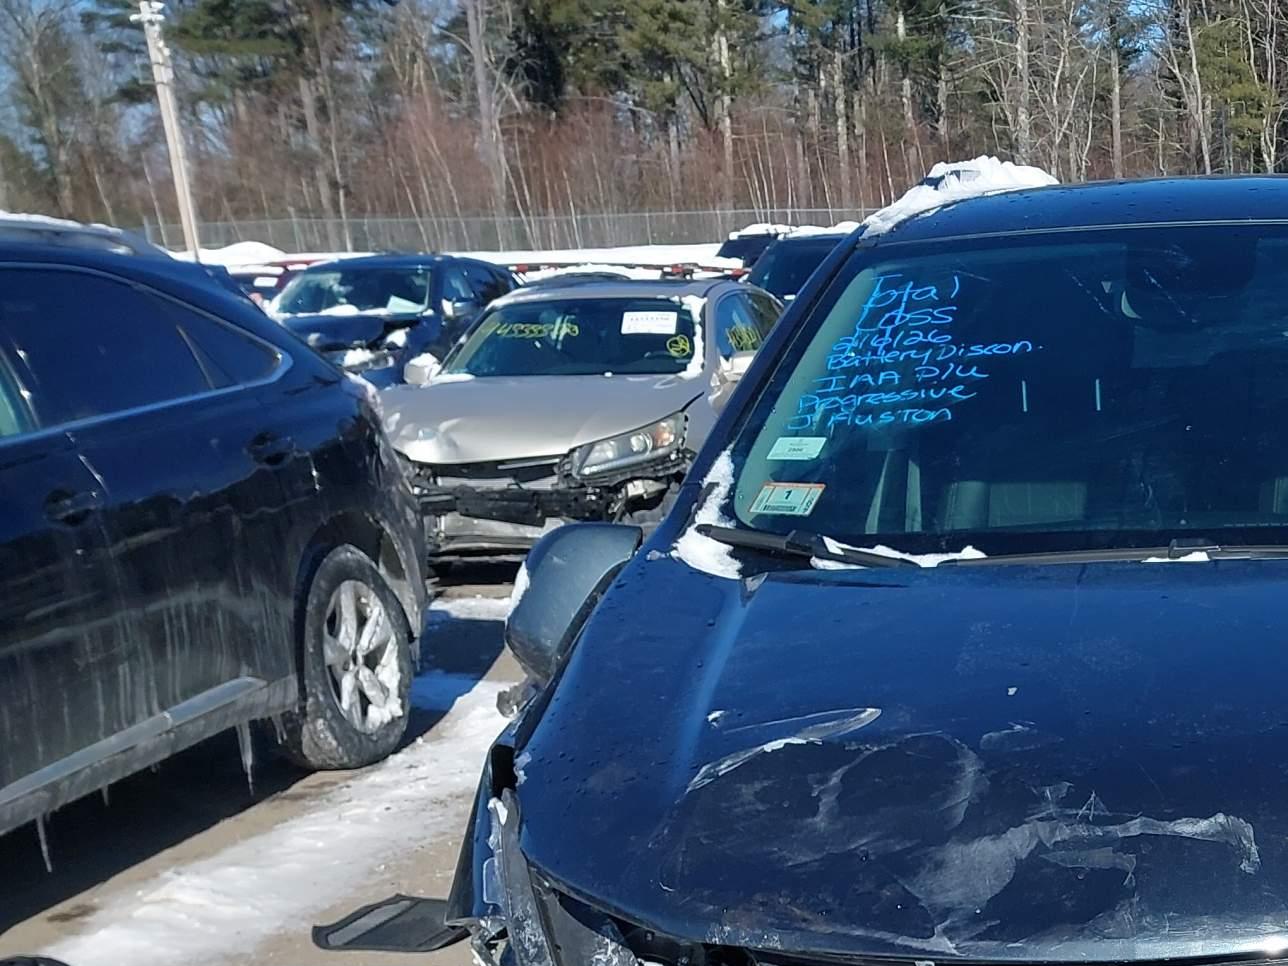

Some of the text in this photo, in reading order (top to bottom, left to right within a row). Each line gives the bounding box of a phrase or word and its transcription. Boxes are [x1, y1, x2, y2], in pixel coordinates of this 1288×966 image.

[871, 274, 960, 307] Total
[832, 329, 952, 351] 2/6/26
[814, 370, 901, 394] IAA
